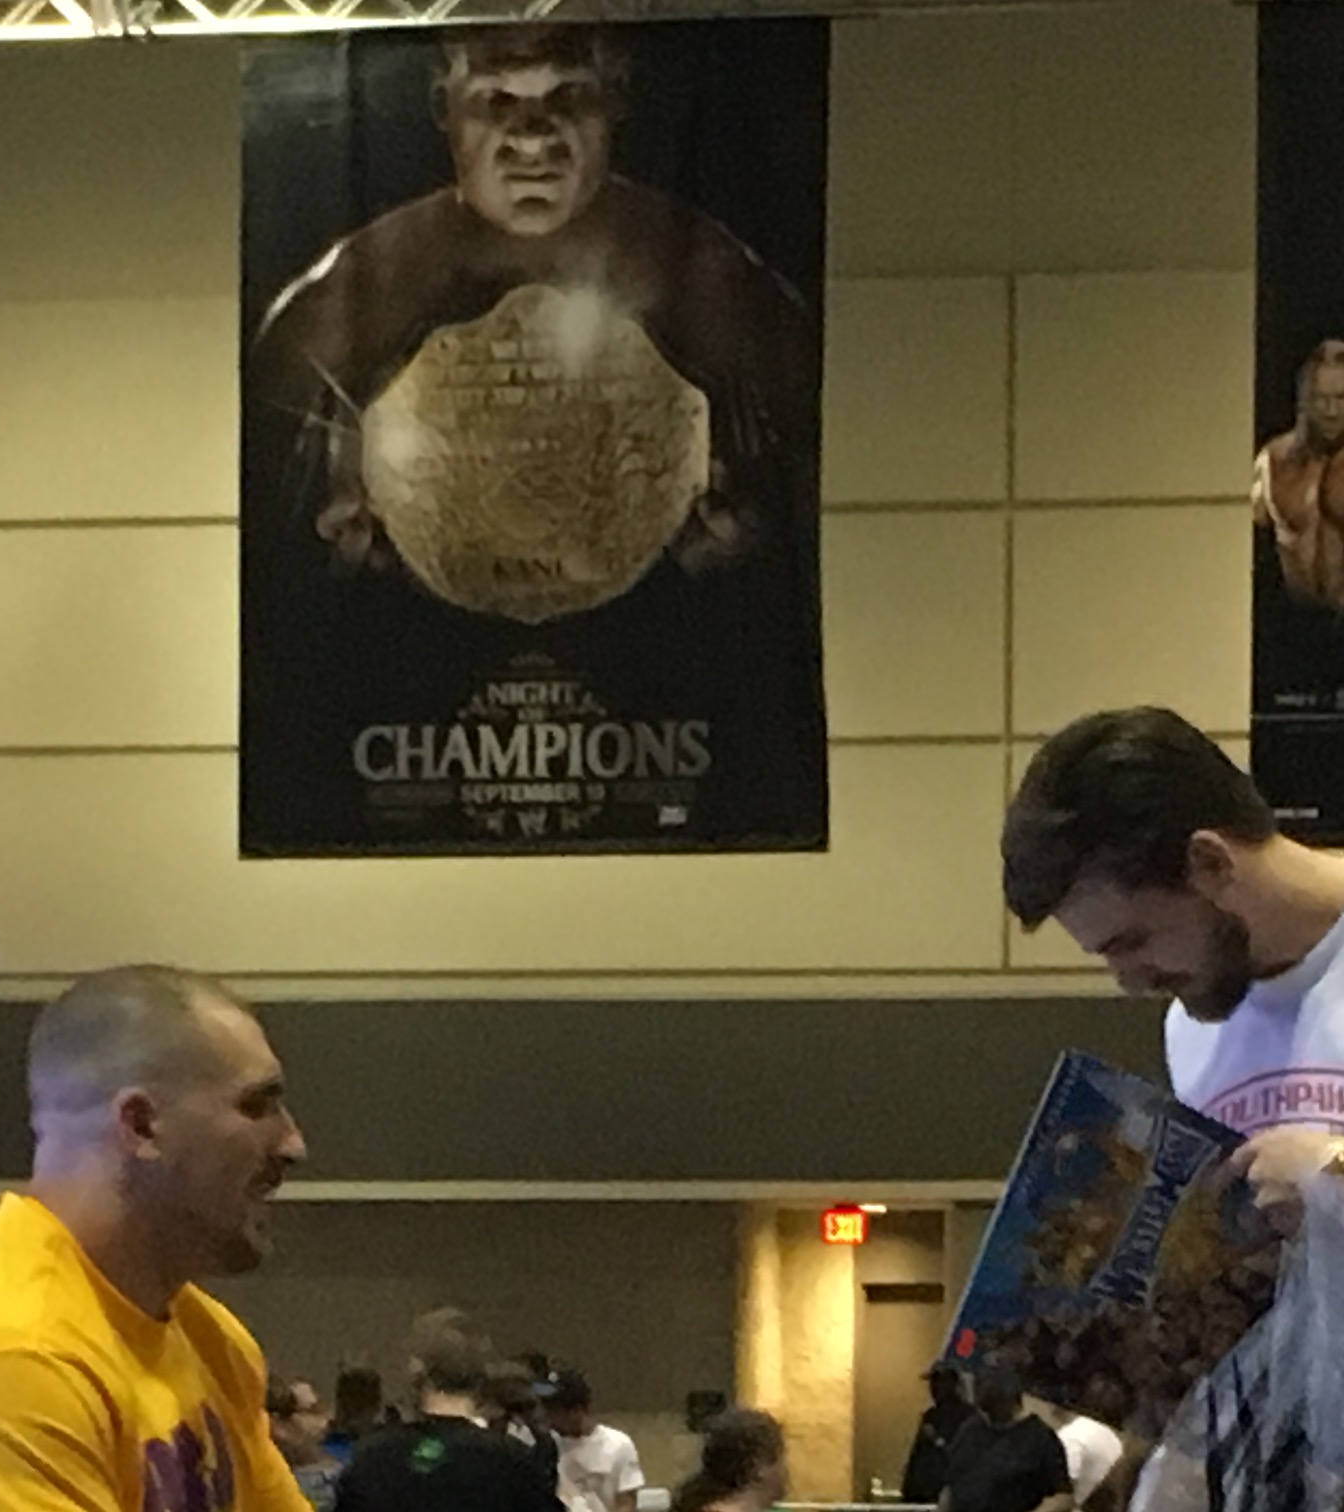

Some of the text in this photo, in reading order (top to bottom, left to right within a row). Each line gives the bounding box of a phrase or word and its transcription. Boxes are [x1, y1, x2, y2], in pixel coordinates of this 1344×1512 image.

[487, 681, 580, 706] NIGHT
[353, 719, 712, 781] CHAMPIONS
[460, 783, 581, 803] SEPTEMBER
